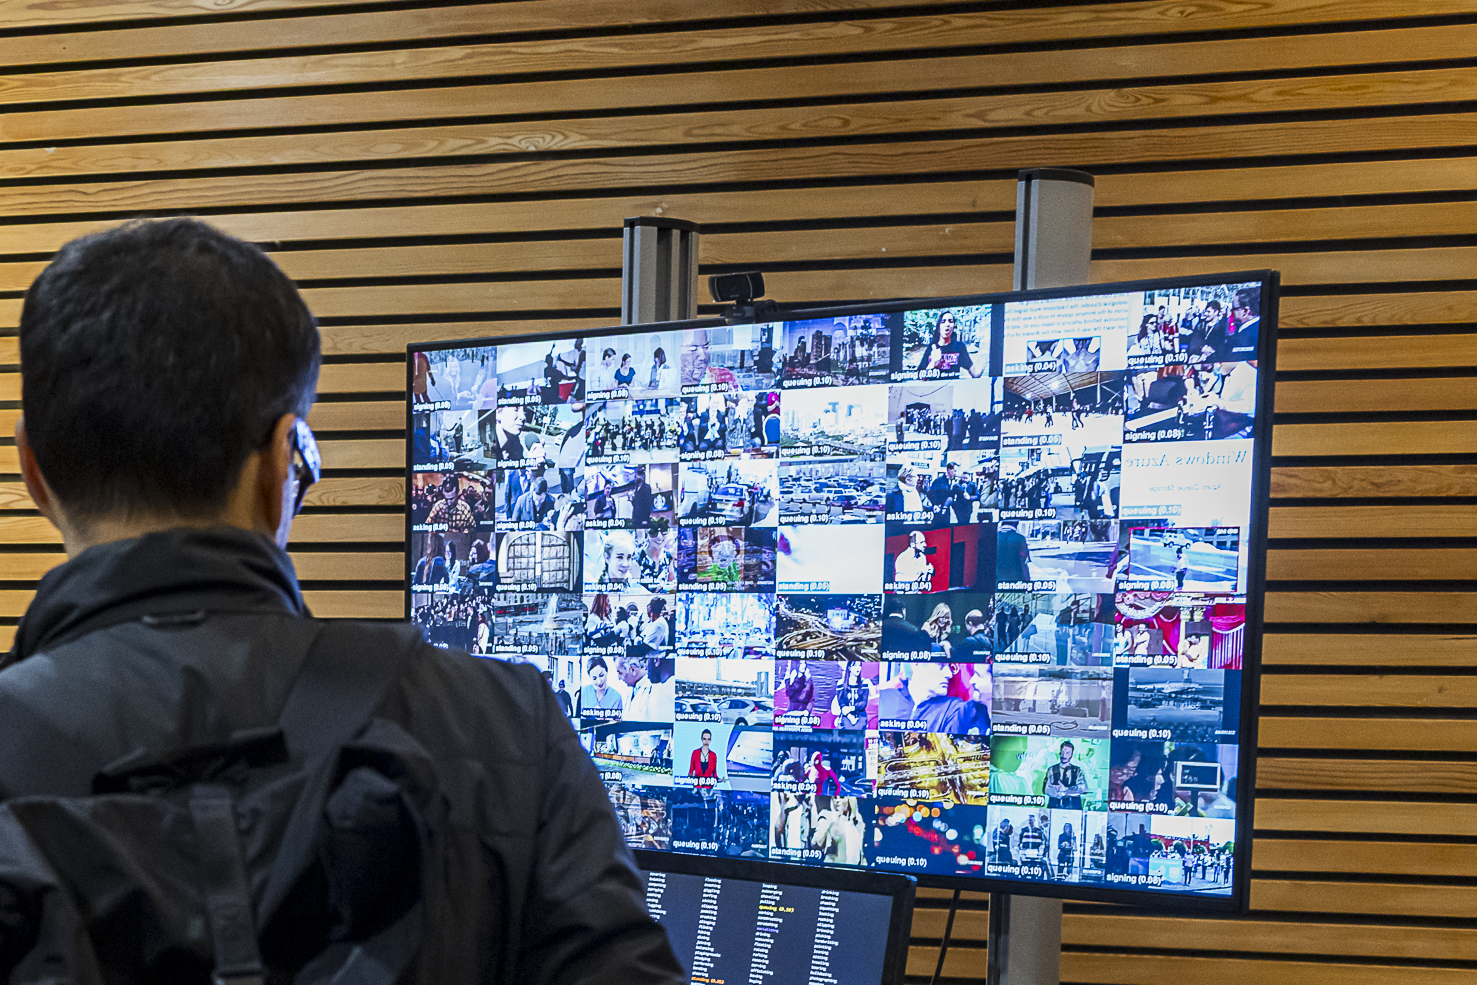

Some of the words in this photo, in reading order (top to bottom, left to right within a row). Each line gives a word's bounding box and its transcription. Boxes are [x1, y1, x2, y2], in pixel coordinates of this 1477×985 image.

[1129, 355, 1164, 366] queuing
[1006, 363, 1033, 373] asking
[891, 371, 918, 381] signing
[783, 378, 812, 388] queuing
[682, 384, 709, 394] queuing
[587, 391, 610, 400] signing
[498, 396, 524, 405] standing
[1125, 430, 1156, 441] signing
[1003, 437, 1038, 447] standing
[889, 442, 920, 452] queuing
[682, 451, 704, 460] signing
[782, 447, 811, 457] queuing
[498, 460, 519, 468] signing
[587, 455, 612, 464] queuing
[413, 463, 438, 472] standing
[1001, 510, 1034, 520] queuing
[1122, 507, 1158, 517] queuing
[780, 515, 809, 524] queuing
[887, 513, 911, 522] asking
[497, 522, 518, 531] signing
[586, 520, 607, 528] asking
[680, 518, 707, 527] queuing
[496, 584, 520, 593] queuing
[679, 583, 707, 592] standing
[778, 582, 809, 591] standing
[885, 582, 909, 591] asking
[998, 581, 1033, 591] standing
[1119, 581, 1150, 591] signing
[496, 645, 521, 653] standing
[584, 647, 606, 656] signing
[677, 649, 705, 657] queuing
[777, 651, 806, 660] queuing
[882, 652, 911, 661] signing
[995, 654, 1028, 664] queuing
[1116, 656, 1152, 666] standing
[583, 710, 604, 718] asking
[676, 713, 703, 722] queuing
[775, 716, 800, 725] signing
[880, 721, 905, 729] asking
[992, 725, 1028, 734] standing
[1113, 729, 1147, 739] queuing
[675, 777, 698, 786] signing
[773, 783, 797, 791] asking
[878, 788, 909, 798] queuing
[990, 795, 1022, 804] queuing
[1110, 802, 1144, 812] queuing
[673, 841, 700, 850] queuing
[772, 848, 802, 859] standing
[876, 856, 906, 866] queuing
[988, 864, 1020, 875] queuing
[1107, 874, 1137, 885] signing
